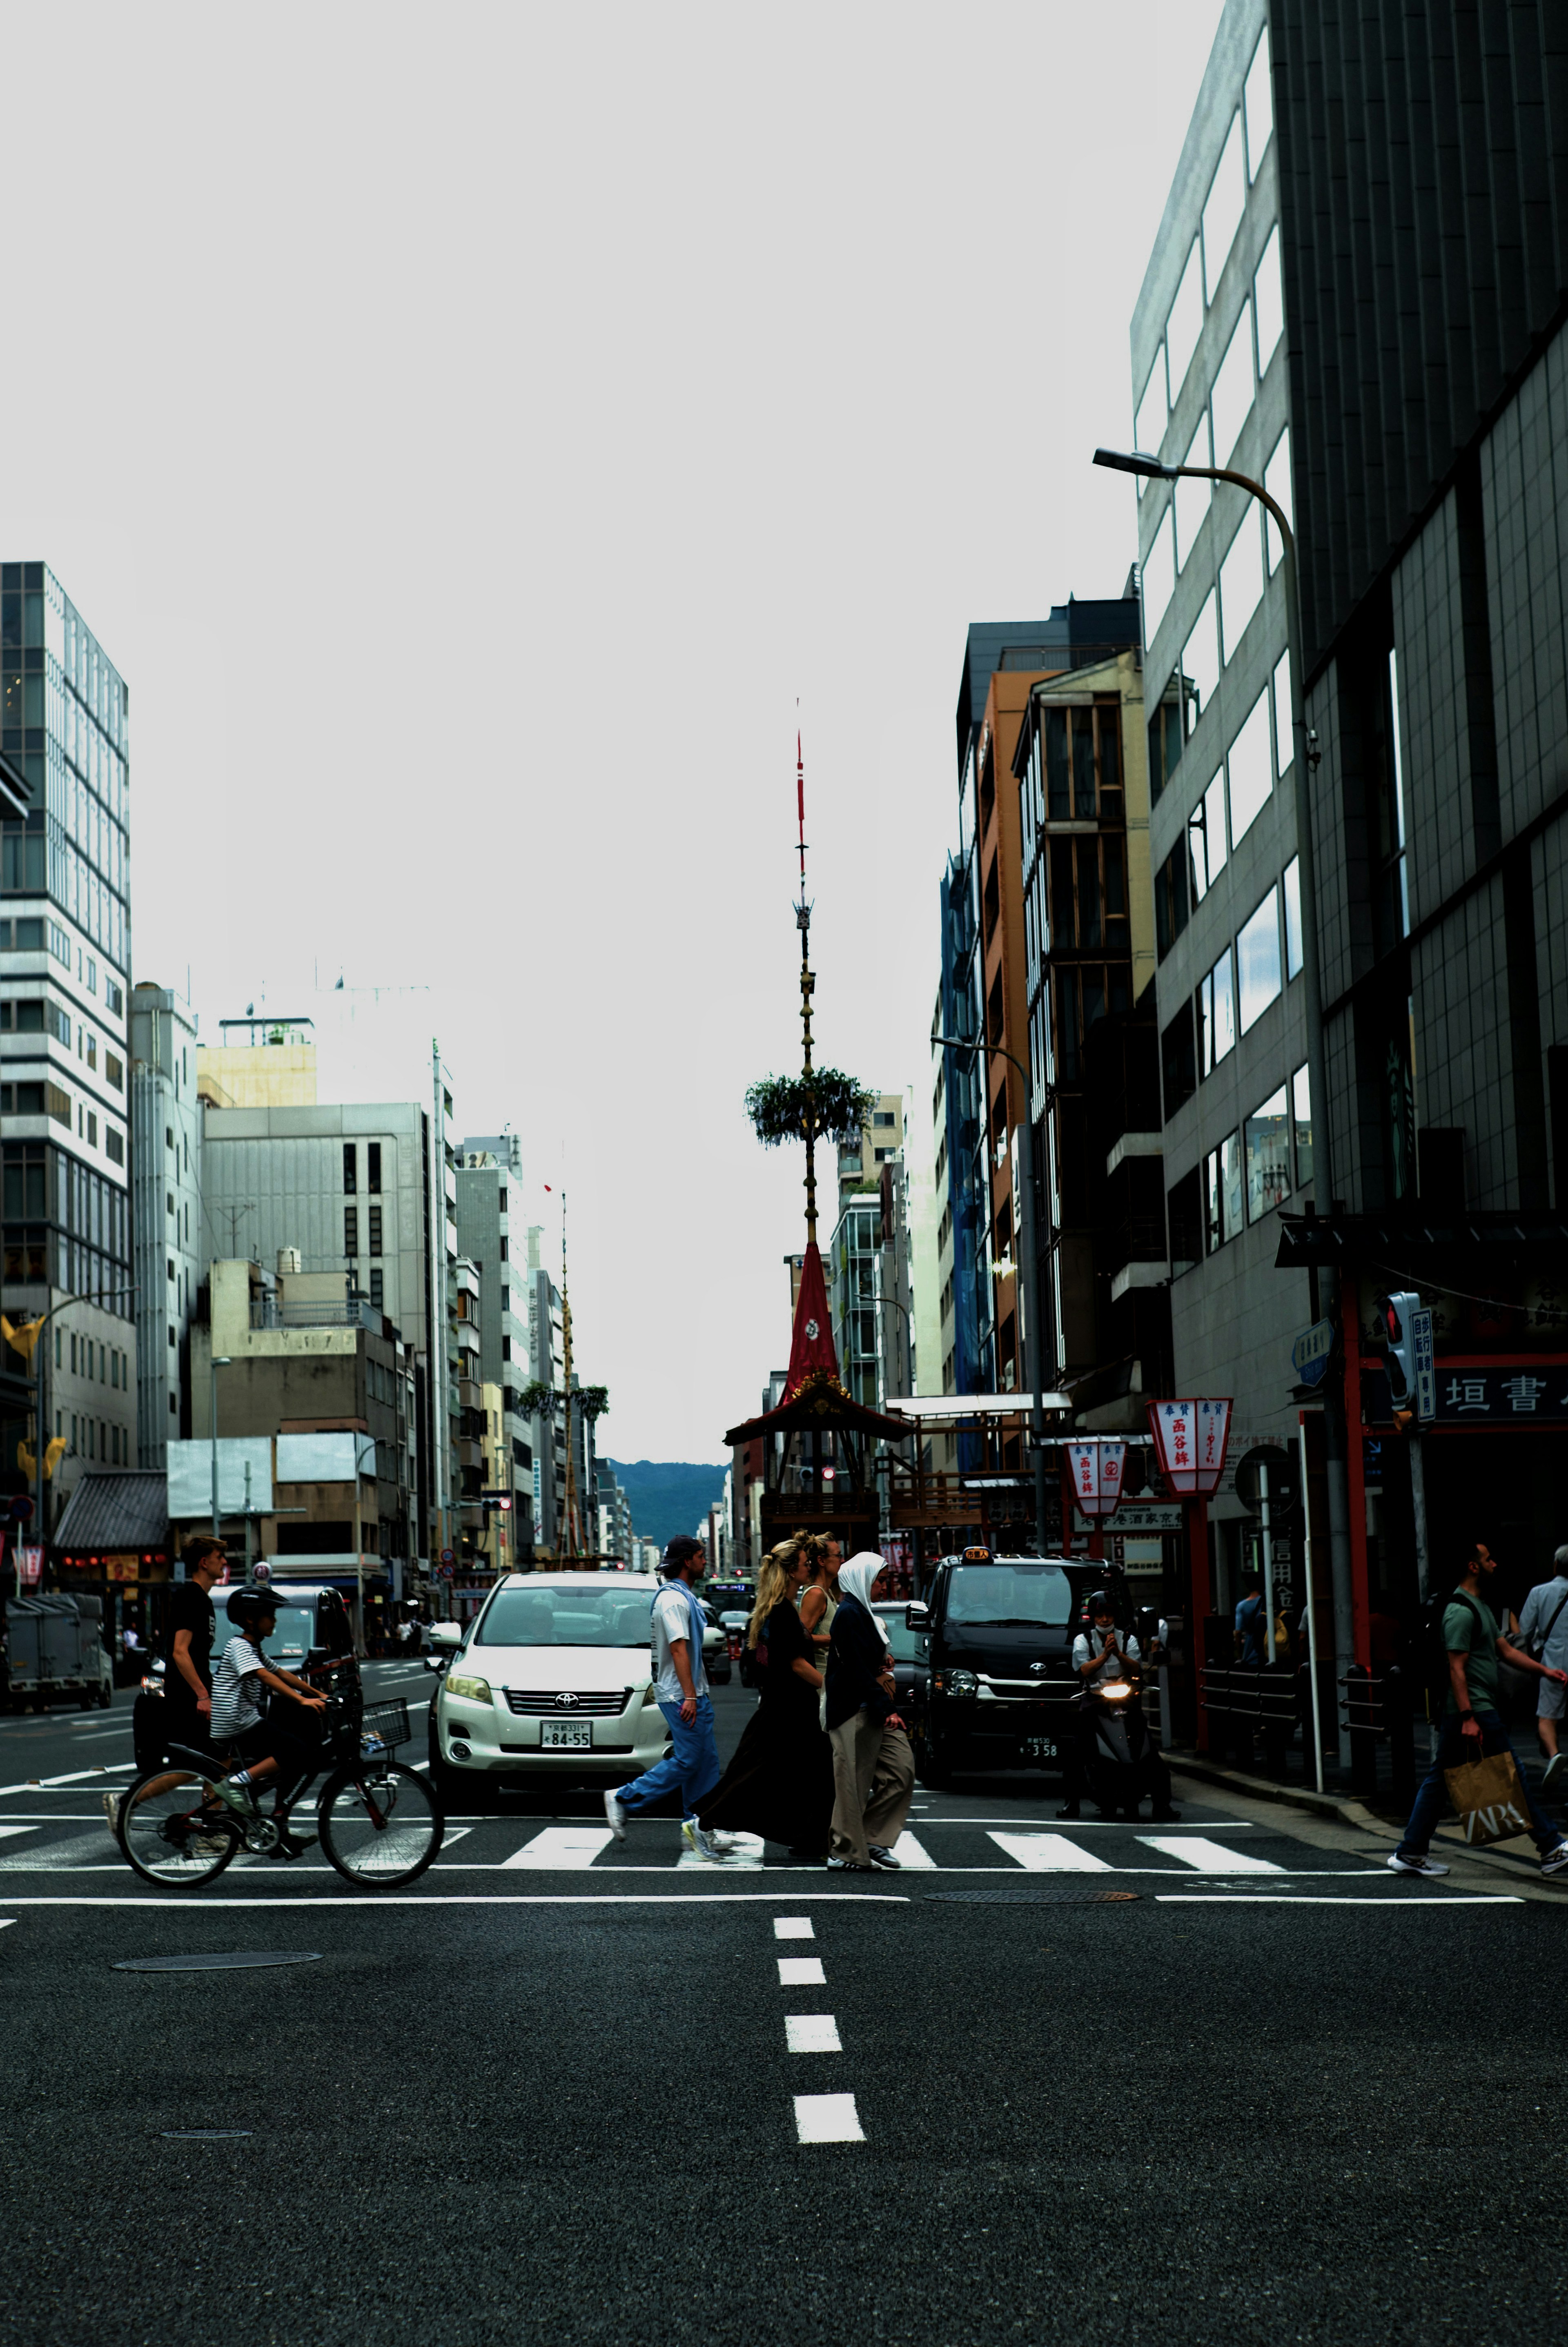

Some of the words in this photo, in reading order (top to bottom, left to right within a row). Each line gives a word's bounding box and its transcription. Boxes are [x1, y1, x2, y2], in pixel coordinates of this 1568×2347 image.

[1446, 1374, 1568, 1412] 垣書
[552, 1732, 589, 1746] 84-55
[1459, 1800, 1528, 1843] ZARA
